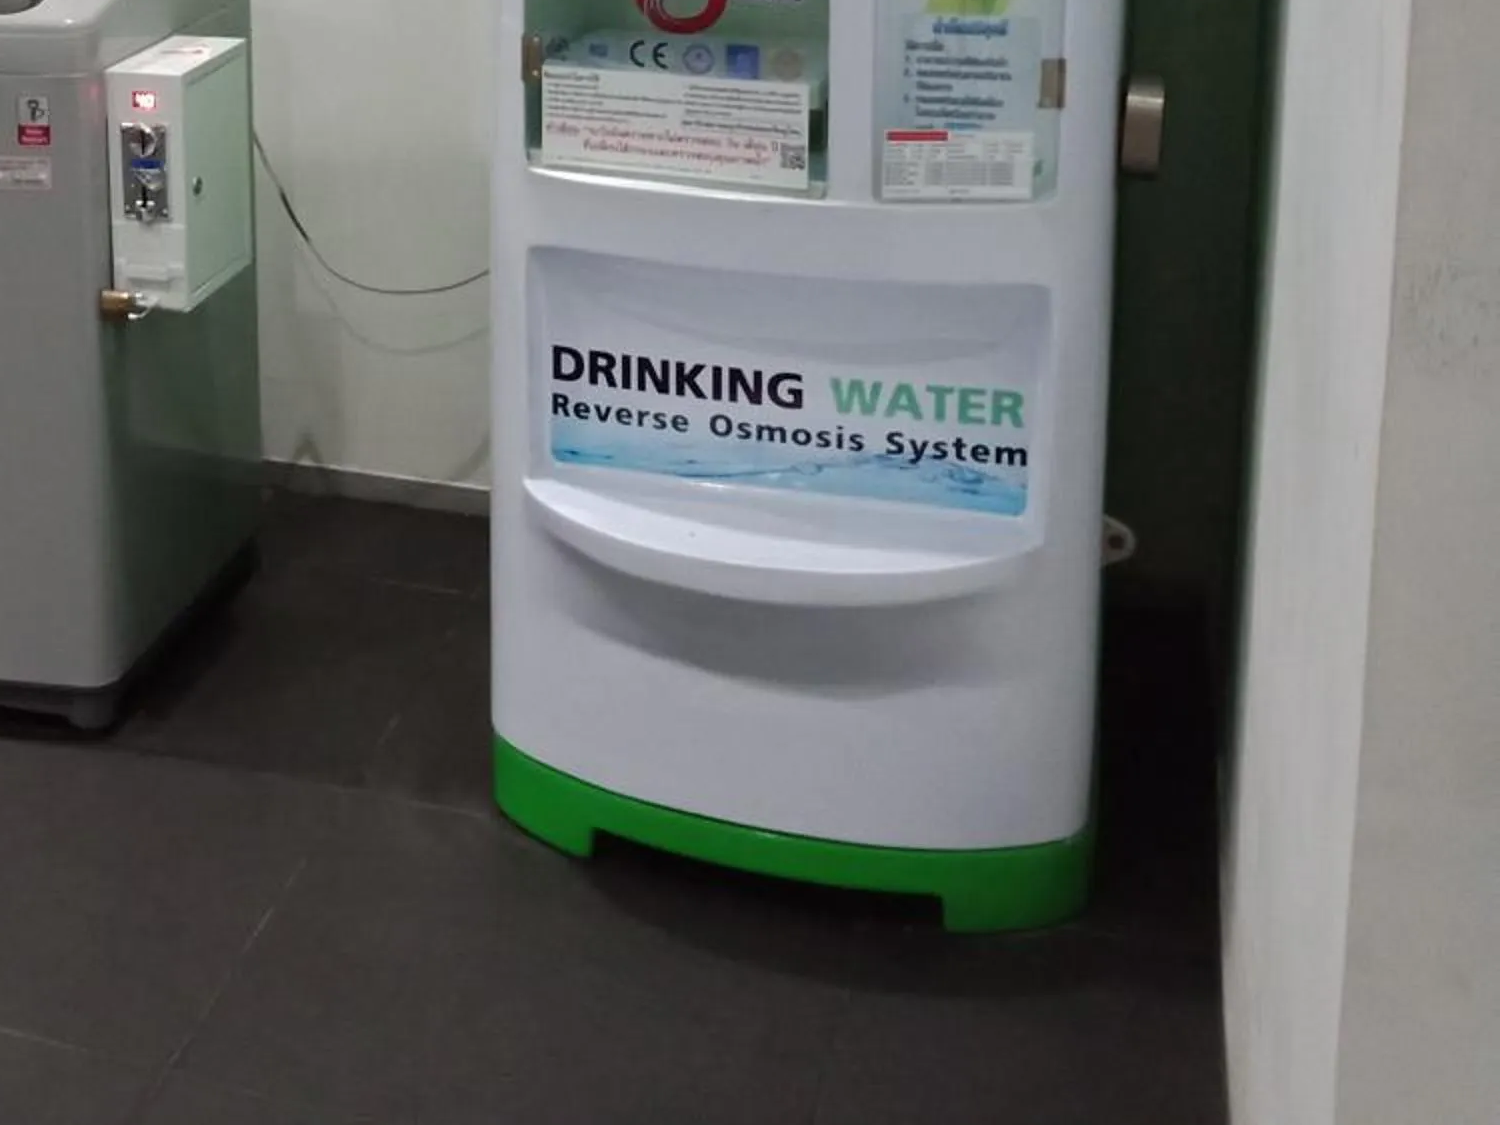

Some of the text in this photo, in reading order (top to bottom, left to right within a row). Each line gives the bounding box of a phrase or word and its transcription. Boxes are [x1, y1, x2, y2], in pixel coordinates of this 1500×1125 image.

[629, 39, 669, 69] CE
[551, 343, 1026, 429] DRINKING WATER
[551, 391, 1028, 468] Reverse Osmosis System
